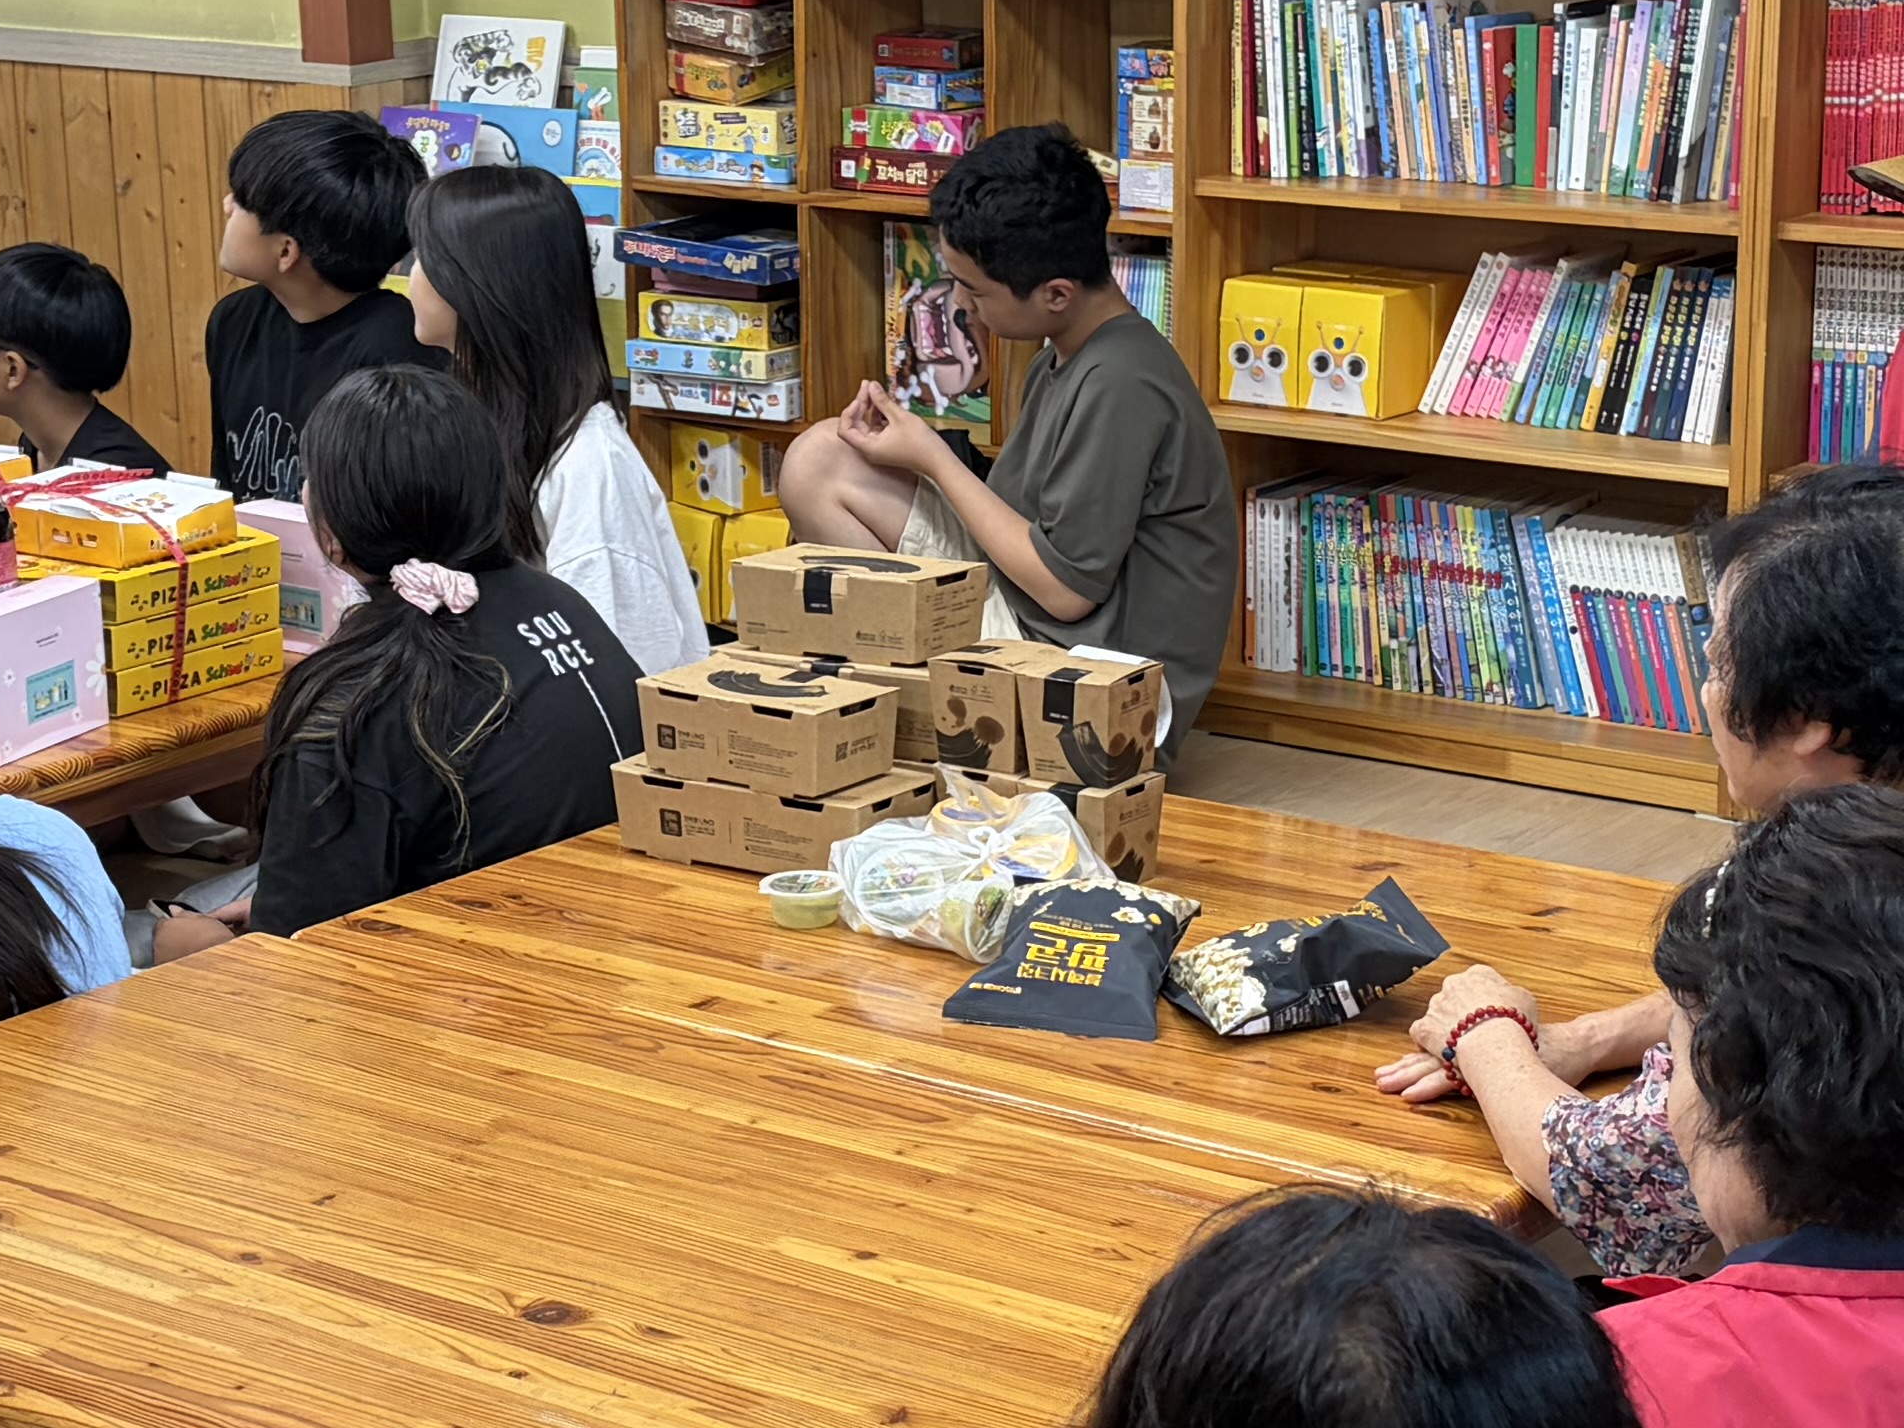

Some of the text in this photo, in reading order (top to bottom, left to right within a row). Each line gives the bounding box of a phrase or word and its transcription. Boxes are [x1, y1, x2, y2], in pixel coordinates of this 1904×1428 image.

[905, 164, 928, 185] 달인
[151, 571, 242, 608] PIZA School
[147, 618, 240, 656] PIZA School
[517, 610, 573, 647] SOU
[541, 638, 595, 676] RCE
[152, 660, 244, 698] PIZA School
